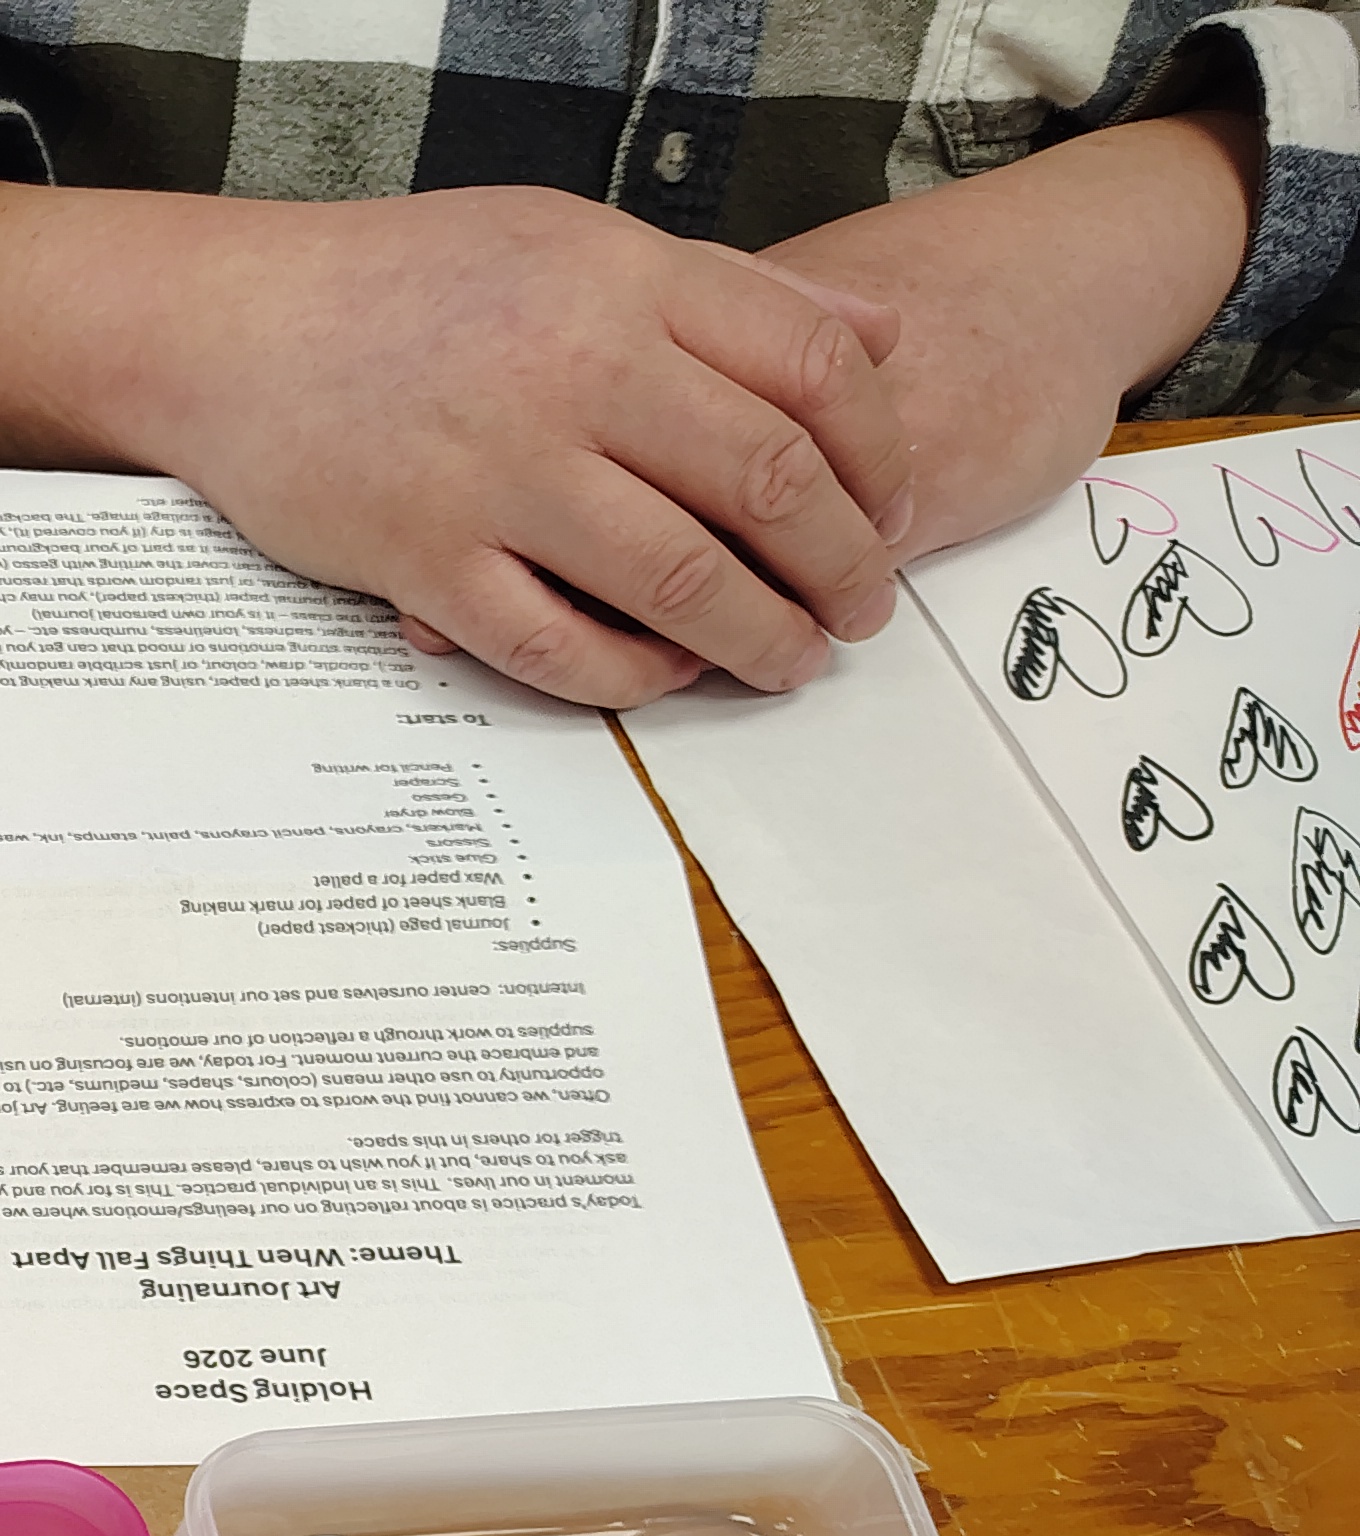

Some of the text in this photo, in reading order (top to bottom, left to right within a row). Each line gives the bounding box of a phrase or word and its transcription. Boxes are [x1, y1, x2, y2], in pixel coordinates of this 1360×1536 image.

[396, 714, 492, 726] To start:
[311, 763, 455, 775] Pencil for writing
[393, 777, 462, 788] Scraper
[411, 793, 469, 803] Gesso
[384, 807, 476, 818] Blow dryer
[425, 838, 492, 848] Sissors
[408, 854, 498, 866] Glue stick
[313, 870, 504, 889] Wax paper for a pallet
[179, 895, 506, 916] Blank sheet of paper for mark making
[258, 917, 510, 937] Journal page (thickest paper)
[491, 937, 578, 954] Supplies:
[62, 982, 586, 1008] Intention: center ourselves and set our intentions (internal)
[260, 1203, 290, 1214] our
[294, 1202, 318, 1213] on
[320, 1199, 409, 1216] reflecting
[412, 1199, 467, 1212] about
[471, 1198, 489, 1212] is
[491, 1194, 568, 1212] practice
[570, 1193, 642, 1210] Today's
[2, 1207, 30, 1217] we
[32, 1206, 90, 1220] where
[91, 1202, 256, 1219] feelings/emotions
[11, 1245, 462, 1270] Theme: When Things Fall Apart
[139, 1279, 341, 1302] Art Journaling
[183, 1348, 327, 1369] June 2026
[155, 1378, 372, 1403] Holding Space
